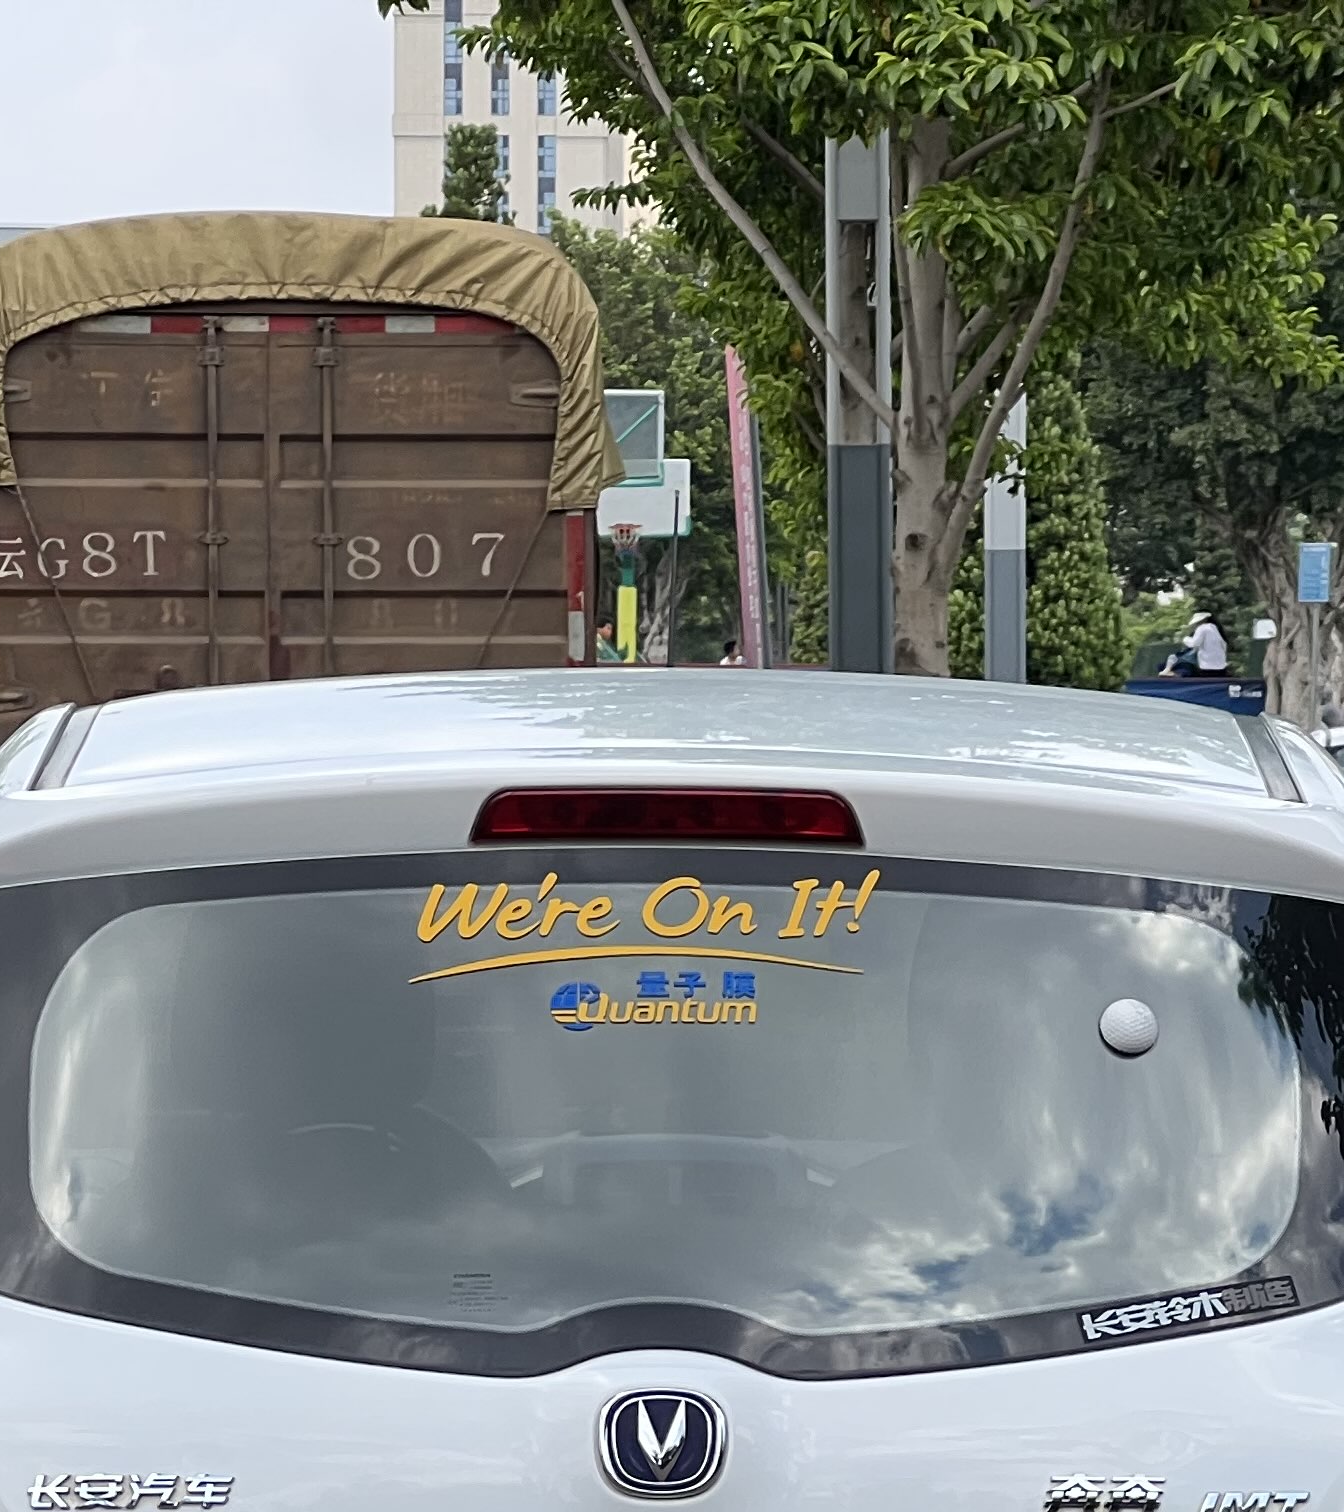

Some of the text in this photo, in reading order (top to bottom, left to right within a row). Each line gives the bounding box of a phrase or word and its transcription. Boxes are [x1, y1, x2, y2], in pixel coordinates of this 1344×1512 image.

[346, 532, 506, 580] 807
[416, 868, 881, 943] We're On It!
[553, 990, 758, 1026] Quantum
[1082, 1279, 1298, 1340] 长安铃木制造
[27, 1472, 236, 1511] 长安汽车
